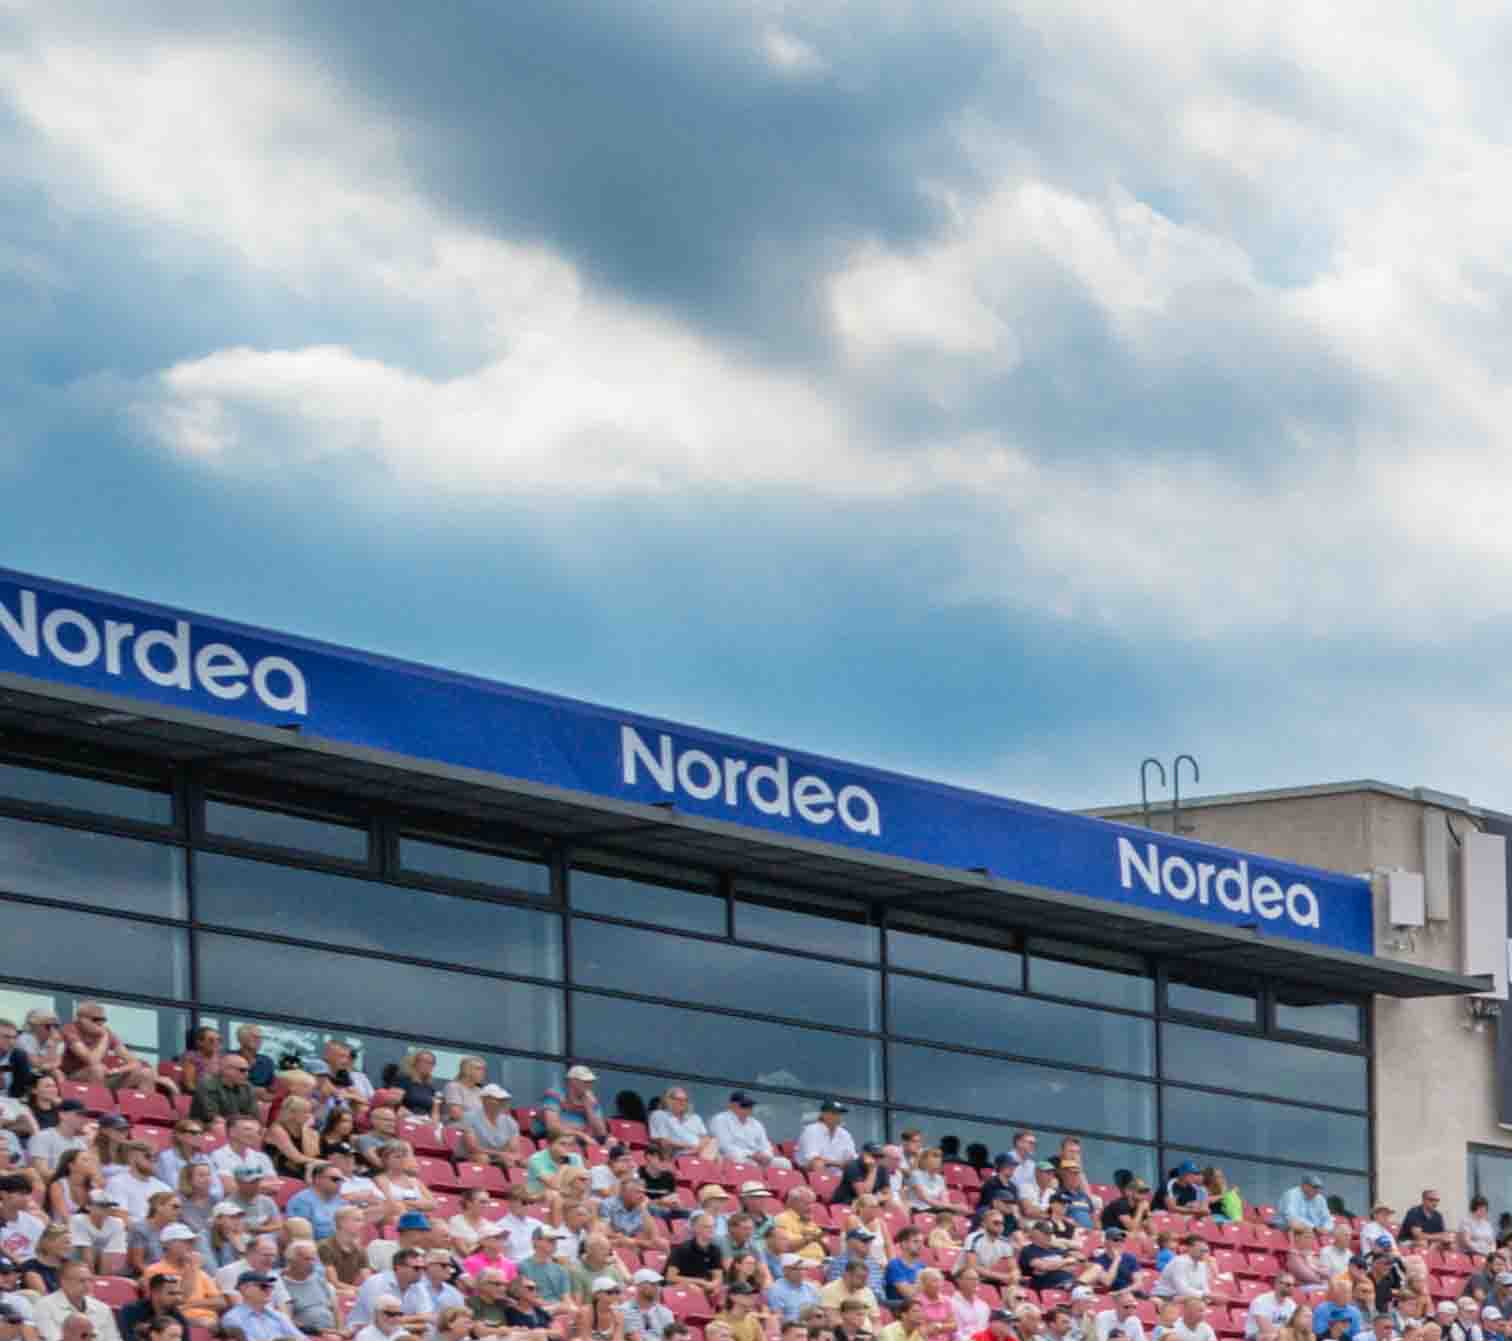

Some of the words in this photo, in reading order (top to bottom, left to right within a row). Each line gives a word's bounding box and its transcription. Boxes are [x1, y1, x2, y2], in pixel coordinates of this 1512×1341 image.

[0, 589, 308, 715] Nordea
[620, 724, 882, 837] Nordea
[1116, 835, 1321, 931] Nordea
